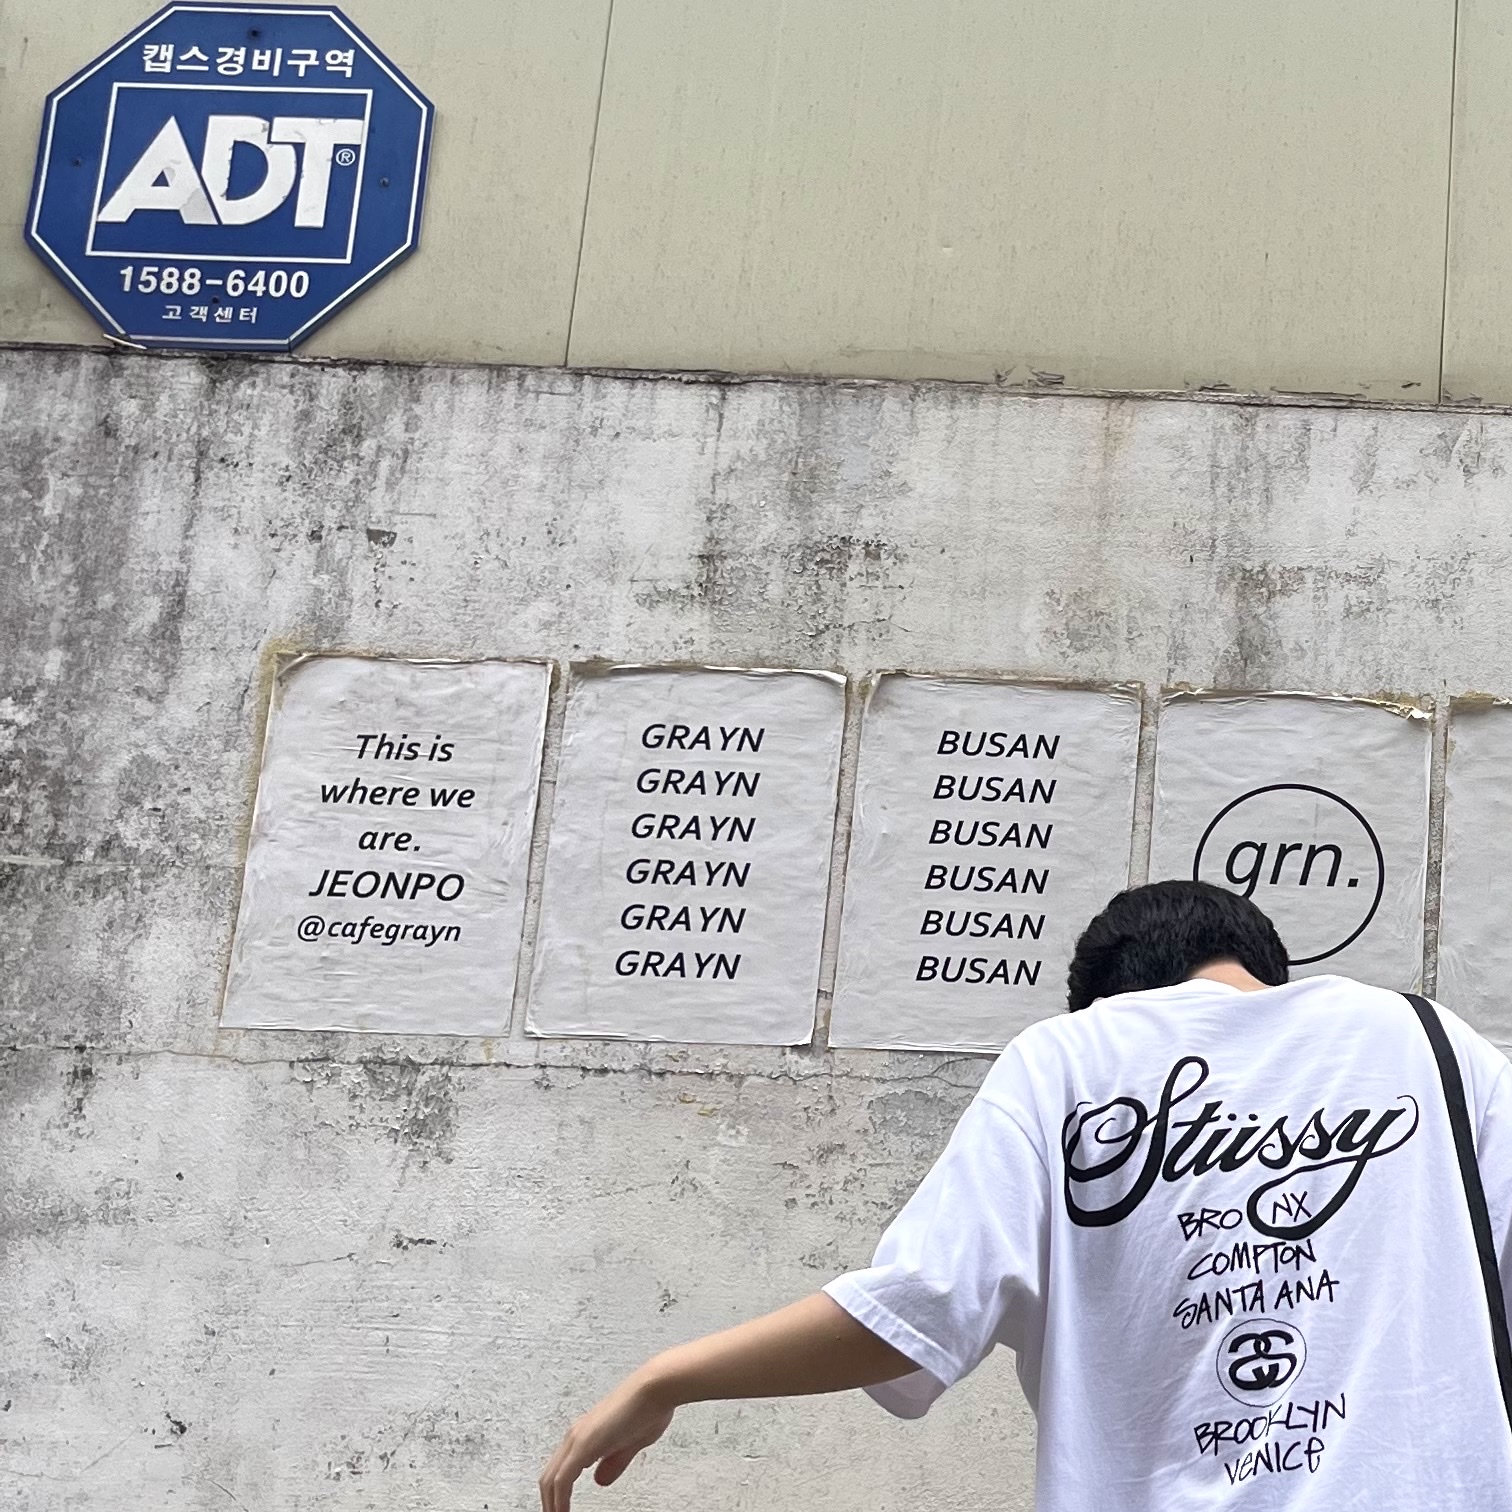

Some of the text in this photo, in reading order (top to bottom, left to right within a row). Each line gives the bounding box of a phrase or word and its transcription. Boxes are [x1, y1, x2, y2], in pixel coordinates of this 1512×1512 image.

[142, 43, 356, 78] 캡스경비구역
[120, 265, 309, 298] 1588-6400
[161, 305, 258, 324] 고객센터
[356, 732, 455, 762] This is
[641, 723, 765, 753] GRAYN
[936, 730, 1061, 760] BUSAN
[321, 777, 476, 808] where we
[636, 768, 761, 798] GRAYN
[932, 774, 1058, 804] BUSAN
[358, 831, 421, 852] are.
[631, 813, 757, 843] GRAYN
[928, 819, 1054, 849] BUSAN
[308, 869, 465, 902] JEONPO
[626, 858, 751, 888] GRAYN
[924, 864, 1050, 895] BUSAN
[297, 915, 461, 948] @cafegrayn
[620, 903, 747, 934] GRAYN
[919, 909, 1046, 940] BUSAN
[615, 950, 742, 980] GRAYN
[915, 955, 1043, 986] BUSAN
[1187, 1239, 1317, 1280] COMPTON
[1172, 1270, 1340, 1329] SANTA ANA
[1194, 1393, 1346, 1456] BROOKLYN
